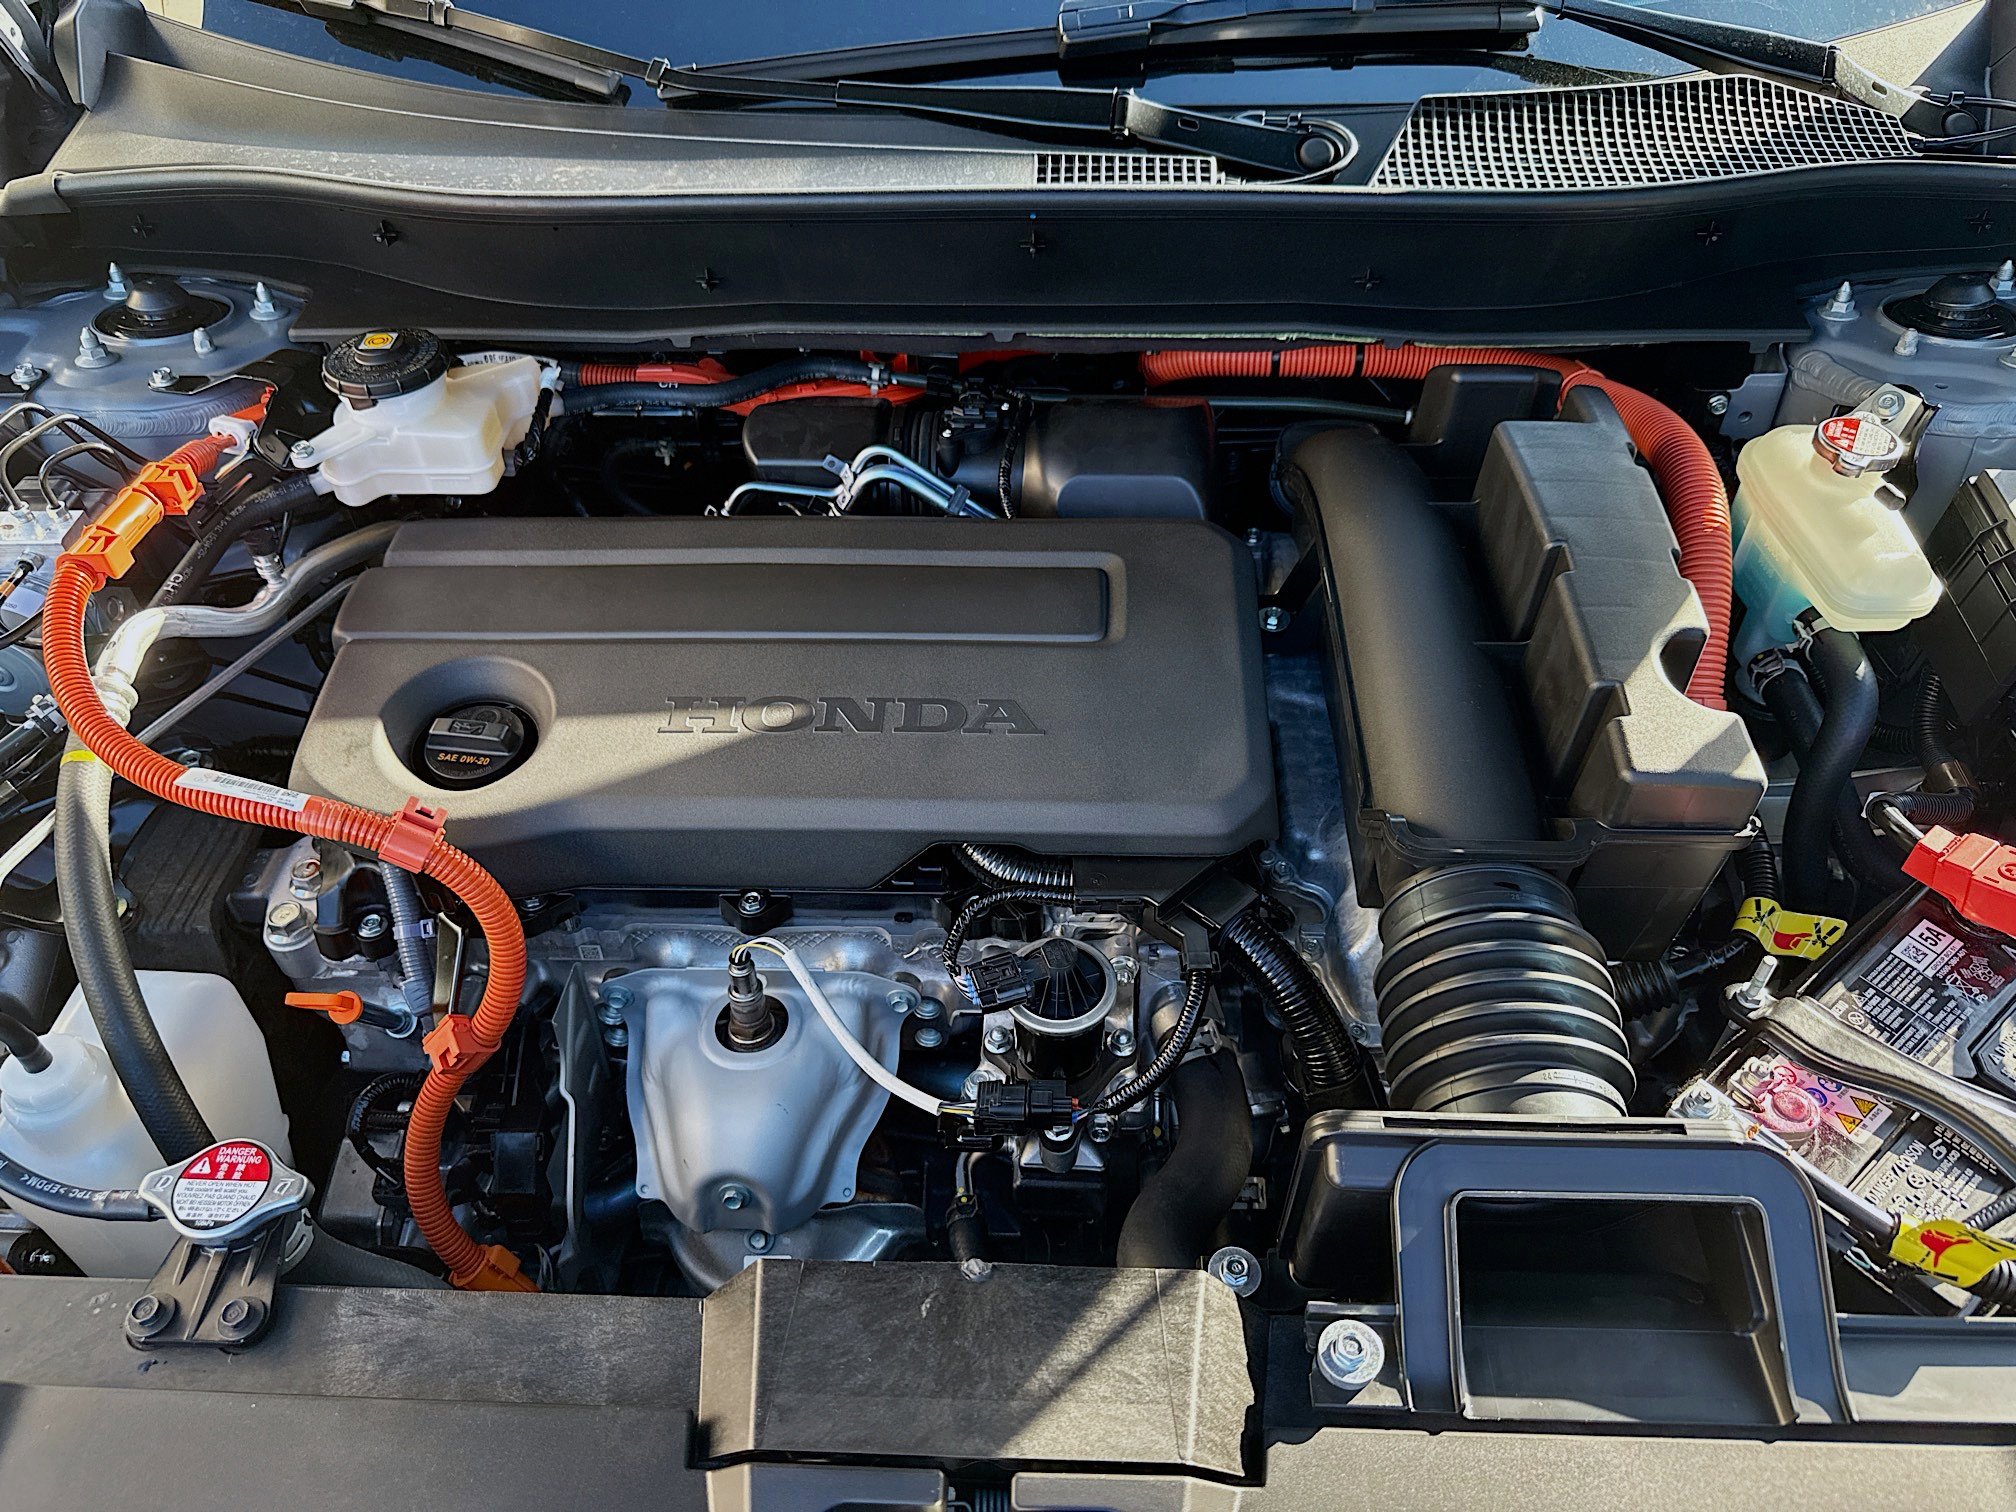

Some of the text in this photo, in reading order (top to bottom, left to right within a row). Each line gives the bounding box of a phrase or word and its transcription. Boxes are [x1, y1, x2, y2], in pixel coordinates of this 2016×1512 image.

[657, 696, 1046, 735] HONDA
[437, 753, 490, 765] SAE 0W-20
[1919, 926, 1946, 948] 5A
[219, 1147, 257, 1155] DANGER
[216, 1154, 262, 1164] WARNUNG
